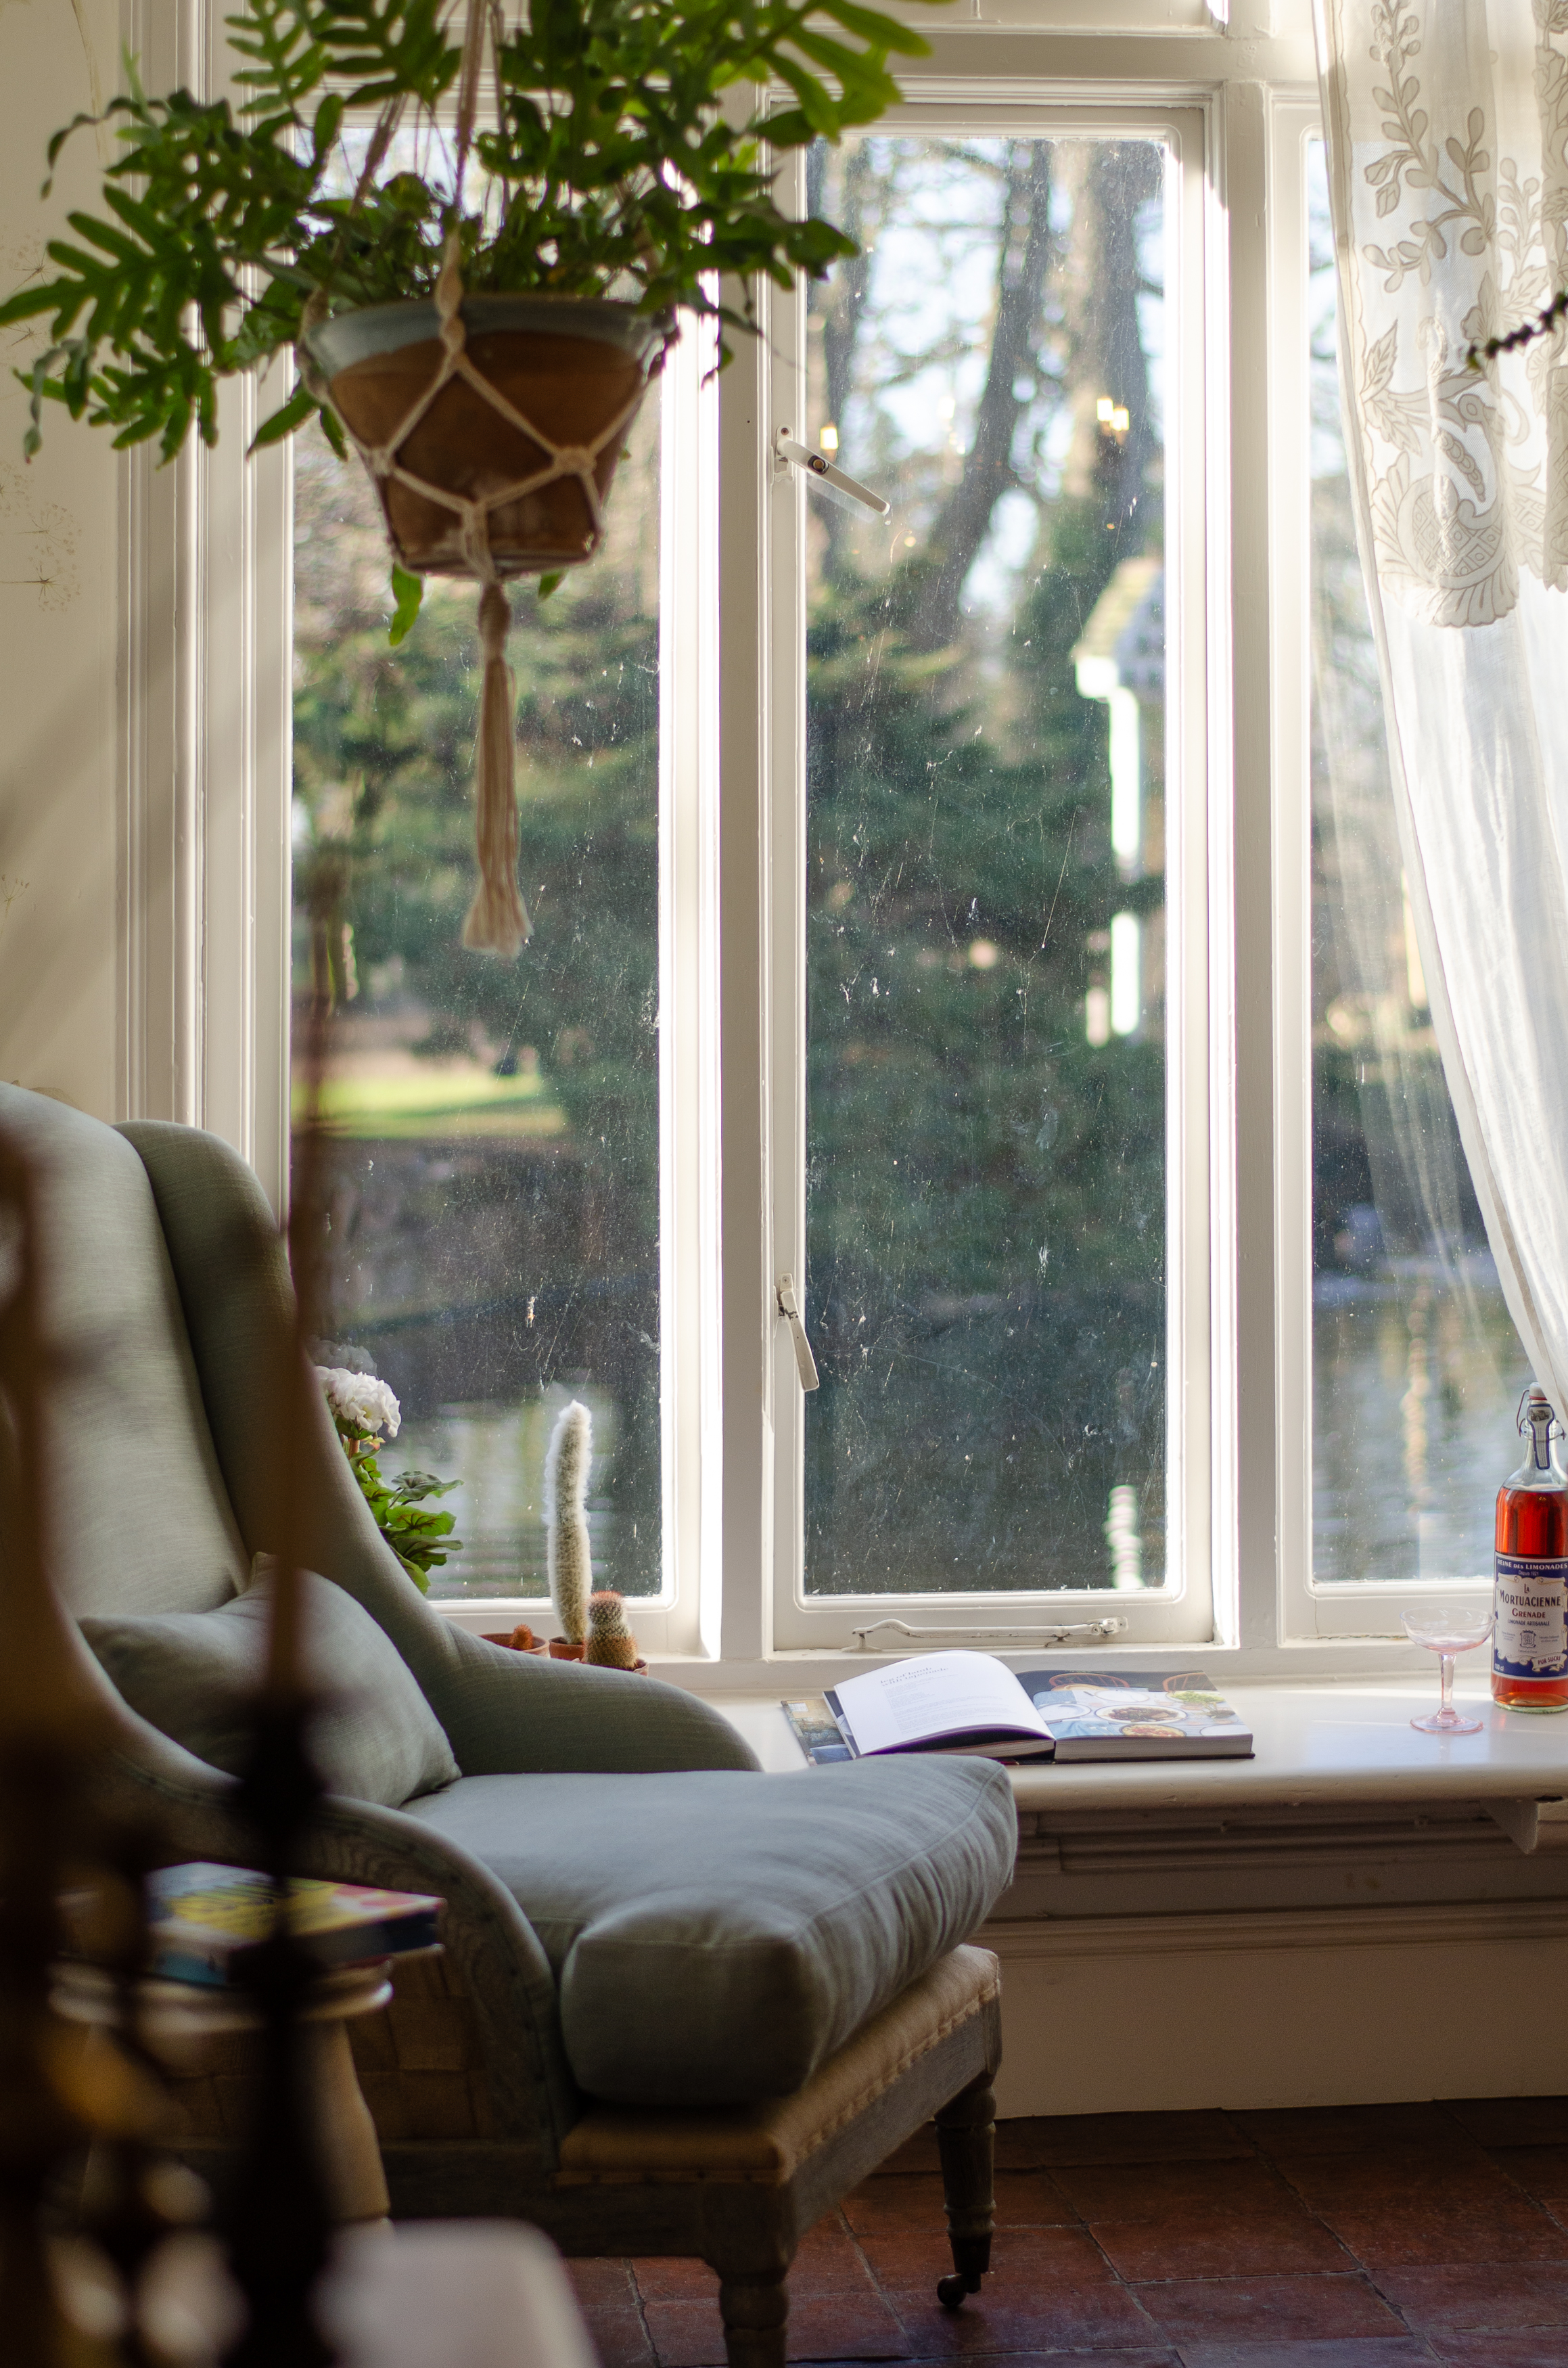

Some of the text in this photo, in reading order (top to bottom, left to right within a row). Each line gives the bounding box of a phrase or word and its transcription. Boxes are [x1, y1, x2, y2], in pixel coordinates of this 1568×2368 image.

[1497, 1559, 1512, 1567] REINE
[1500, 1589, 1561, 1607] MORTUACIENNE
[1512, 1608, 1546, 1618] GRENADE
